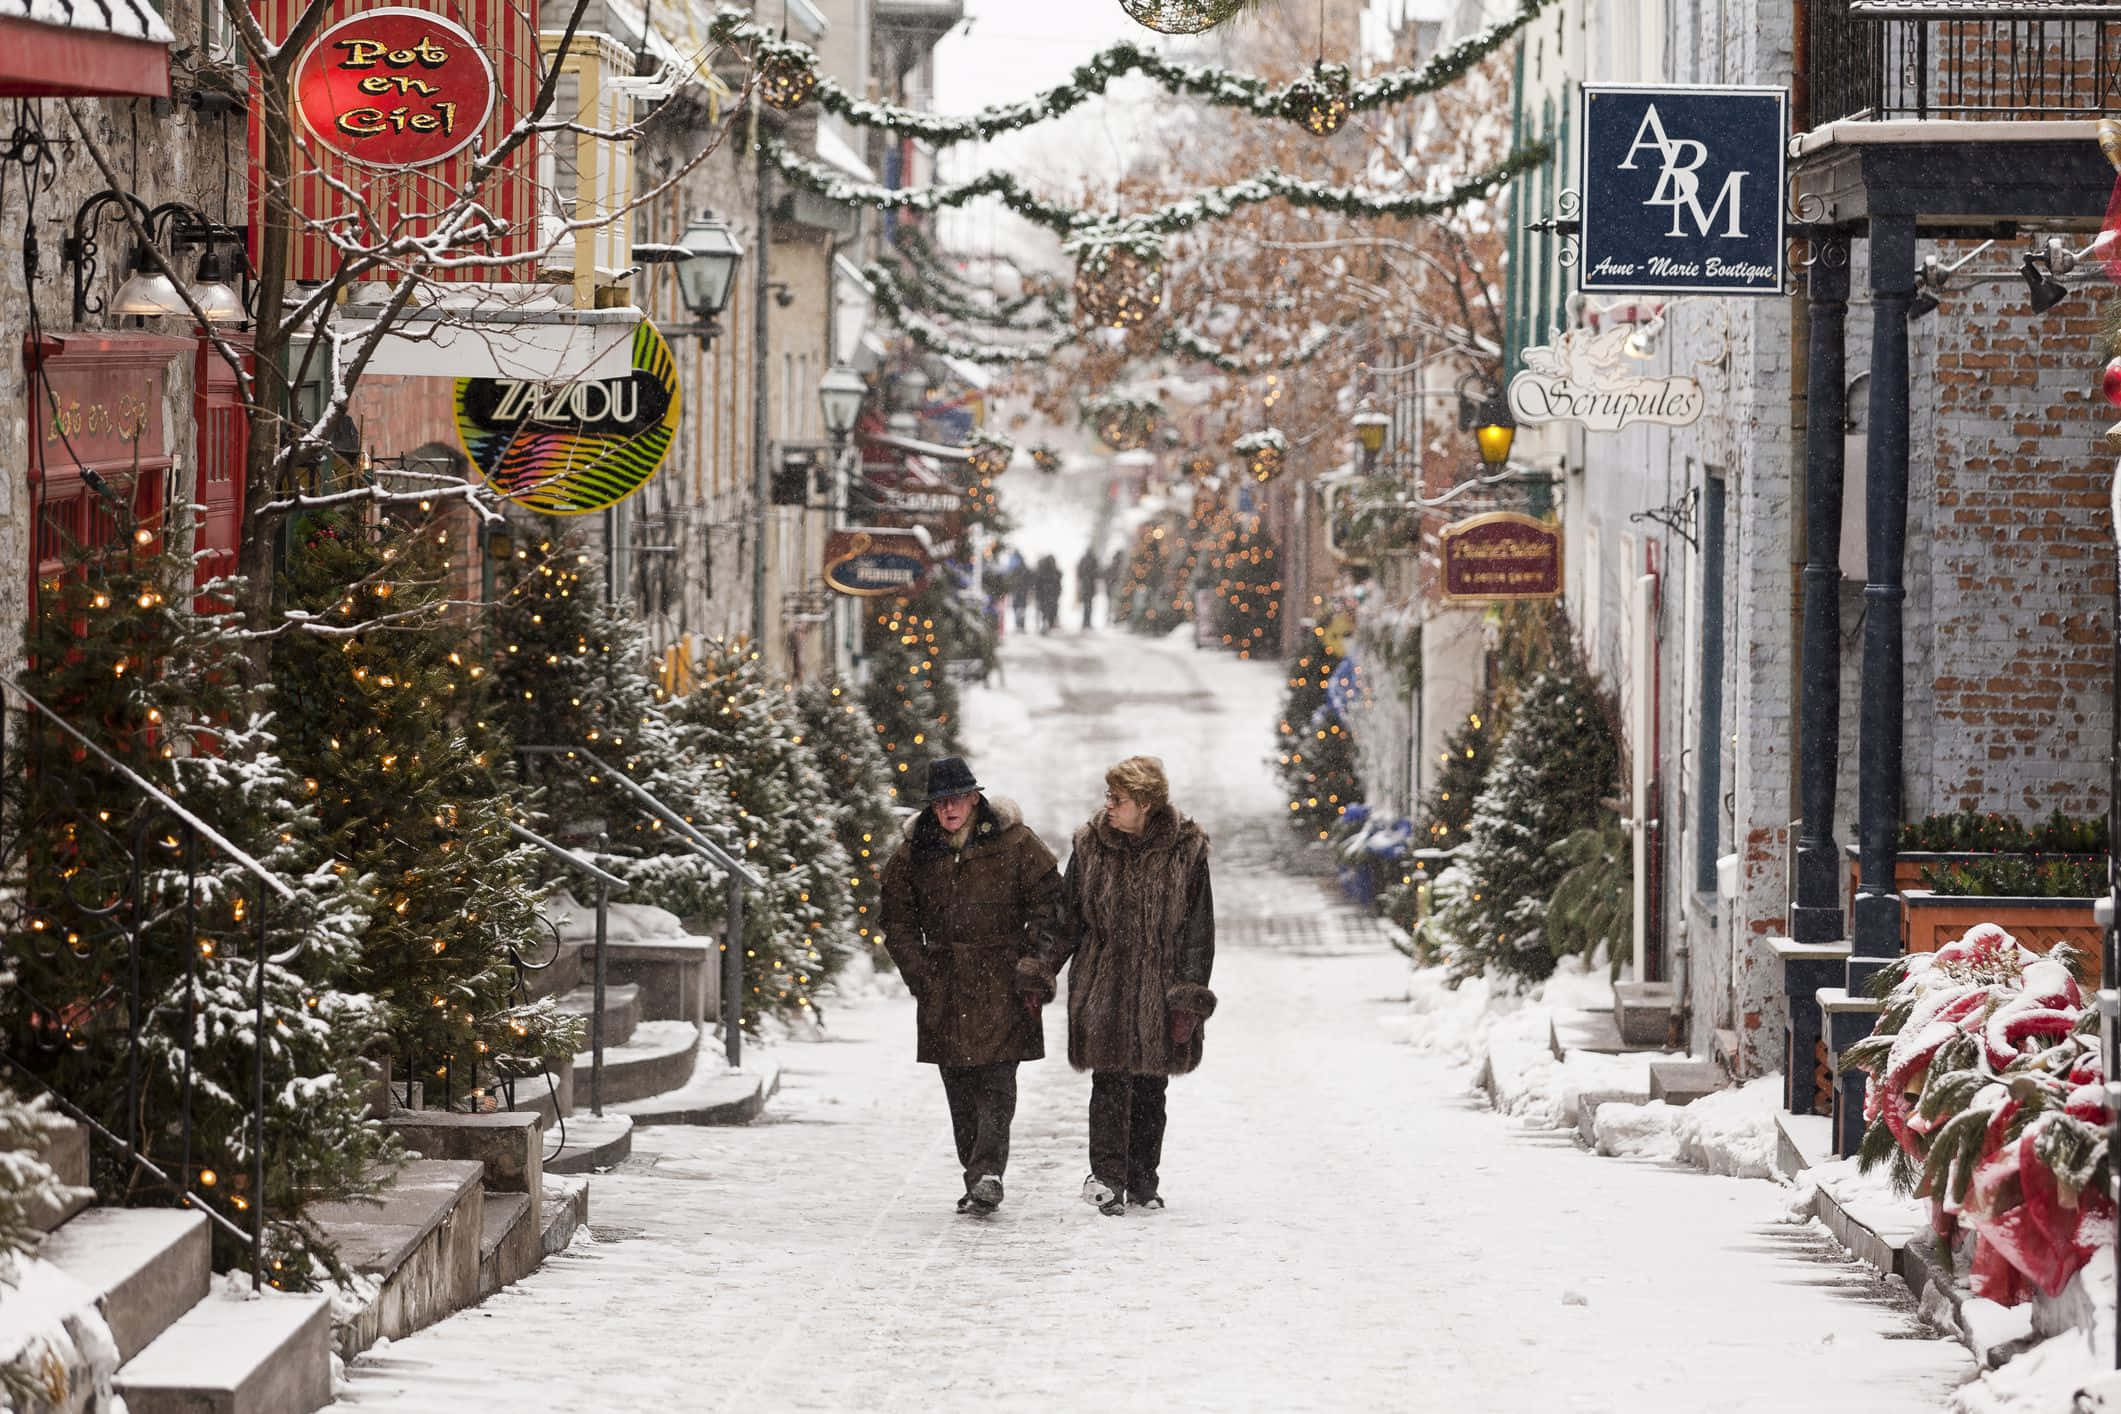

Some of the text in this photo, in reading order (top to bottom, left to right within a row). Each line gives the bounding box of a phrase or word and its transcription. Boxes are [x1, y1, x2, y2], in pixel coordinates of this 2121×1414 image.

[335, 37, 449, 69] Pot
[358, 76, 441, 97] en
[335, 103, 457, 137] Ciel
[1705, 256, 1773, 284] Boutique
[491, 380, 638, 423] ZAZOU
[1516, 379, 1697, 429] Scrupules
